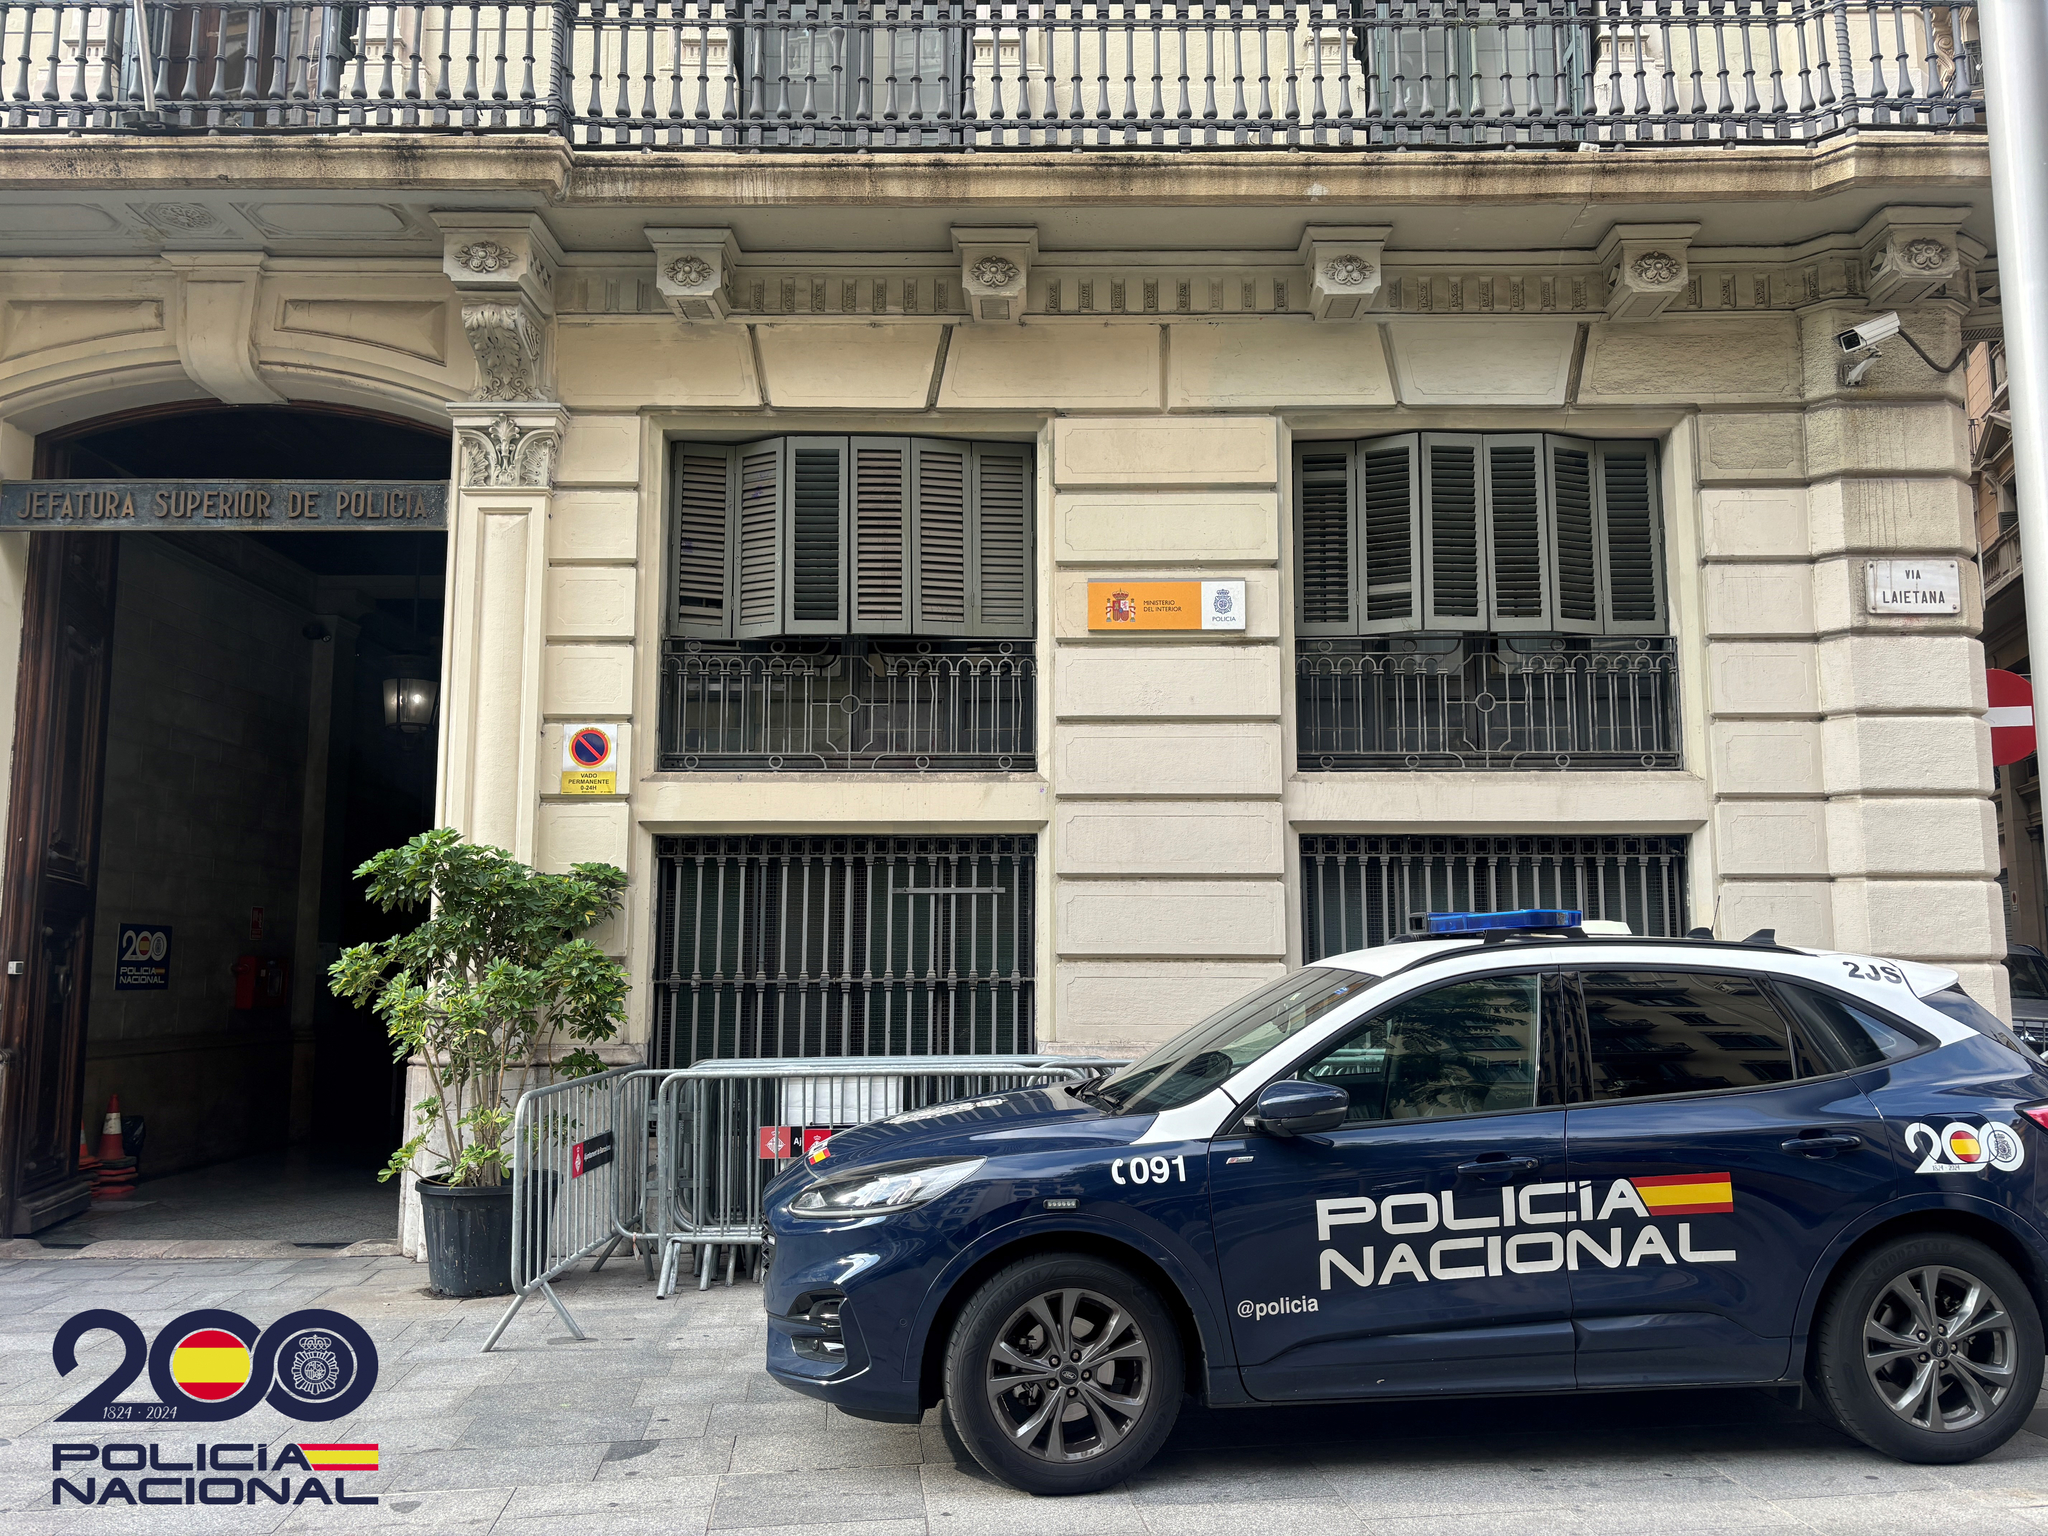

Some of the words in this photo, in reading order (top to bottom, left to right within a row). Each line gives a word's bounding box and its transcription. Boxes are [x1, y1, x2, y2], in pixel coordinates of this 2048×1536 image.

[16, 491, 136, 519] JEFATURA
[154, 490, 271, 519] SUPERIOR
[288, 491, 320, 519] DE
[335, 491, 428, 519] POLICIA
[1905, 570, 1921, 580] VIA
[1882, 591, 1946, 604] LAIETANA
[122, 930, 167, 961] 200
[119, 976, 165, 984] NACIONAL
[1904, 1121, 2025, 1174] 200
[1129, 1154, 1187, 1185] 091
[1319, 1222, 1737, 1290] NACIONAL
[1236, 1295, 1319, 1321] @policia
